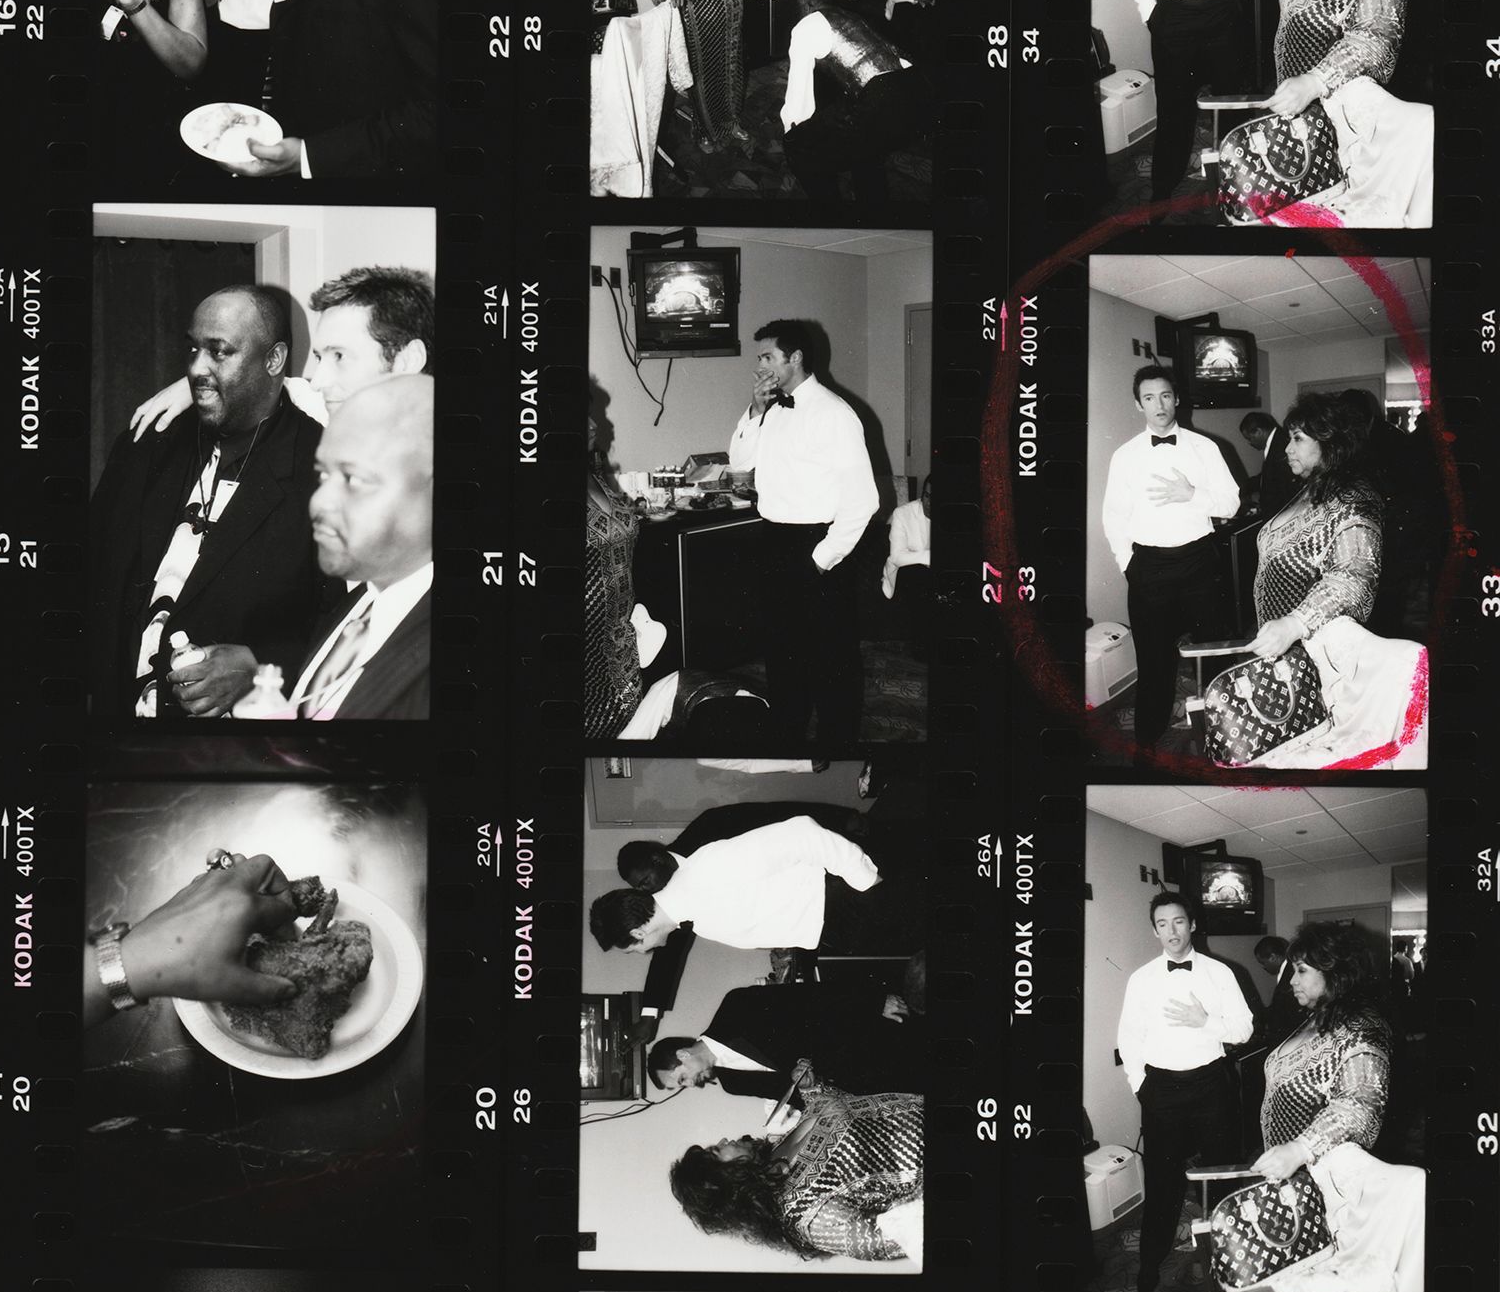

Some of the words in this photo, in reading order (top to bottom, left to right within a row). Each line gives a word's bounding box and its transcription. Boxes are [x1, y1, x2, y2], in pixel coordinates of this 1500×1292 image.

[27, 5, 43, 40] 22
[489, 16, 509, 58] 22
[524, 16, 541, 51] 28
[1023, 28, 1039, 63] 34
[23, 269, 40, 339] 400TX
[522, 282, 538, 352] 400TX
[1020, 296, 1037, 366] 400TX
[21, 356, 39, 449] KODAK
[520, 369, 538, 462] KODAK
[1019, 383, 1037, 476] KODAK
[20, 541, 36, 568] 21
[483, 552, 502, 585] 21
[982, 562, 1002, 603] 27
[1018, 567, 1035, 601] 33
[1482, 575, 1500, 617] 33
[17, 807, 34, 876] 400TX
[477, 823, 490, 866] 20A
[516, 819, 533, 888] 400TX
[978, 834, 990, 877] 26A
[1016, 834, 1033, 904] 400TX
[1478, 848, 1491, 891] 32A
[15, 894, 32, 986] KODAK
[515, 906, 532, 998] KODAK
[1015, 922, 1032, 1014] KODAK
[13, 1077, 30, 1111] 20
[514, 1089, 530, 1123] 26
[977, 1098, 997, 1141] 26
[1014, 1105, 1031, 1139] 32
